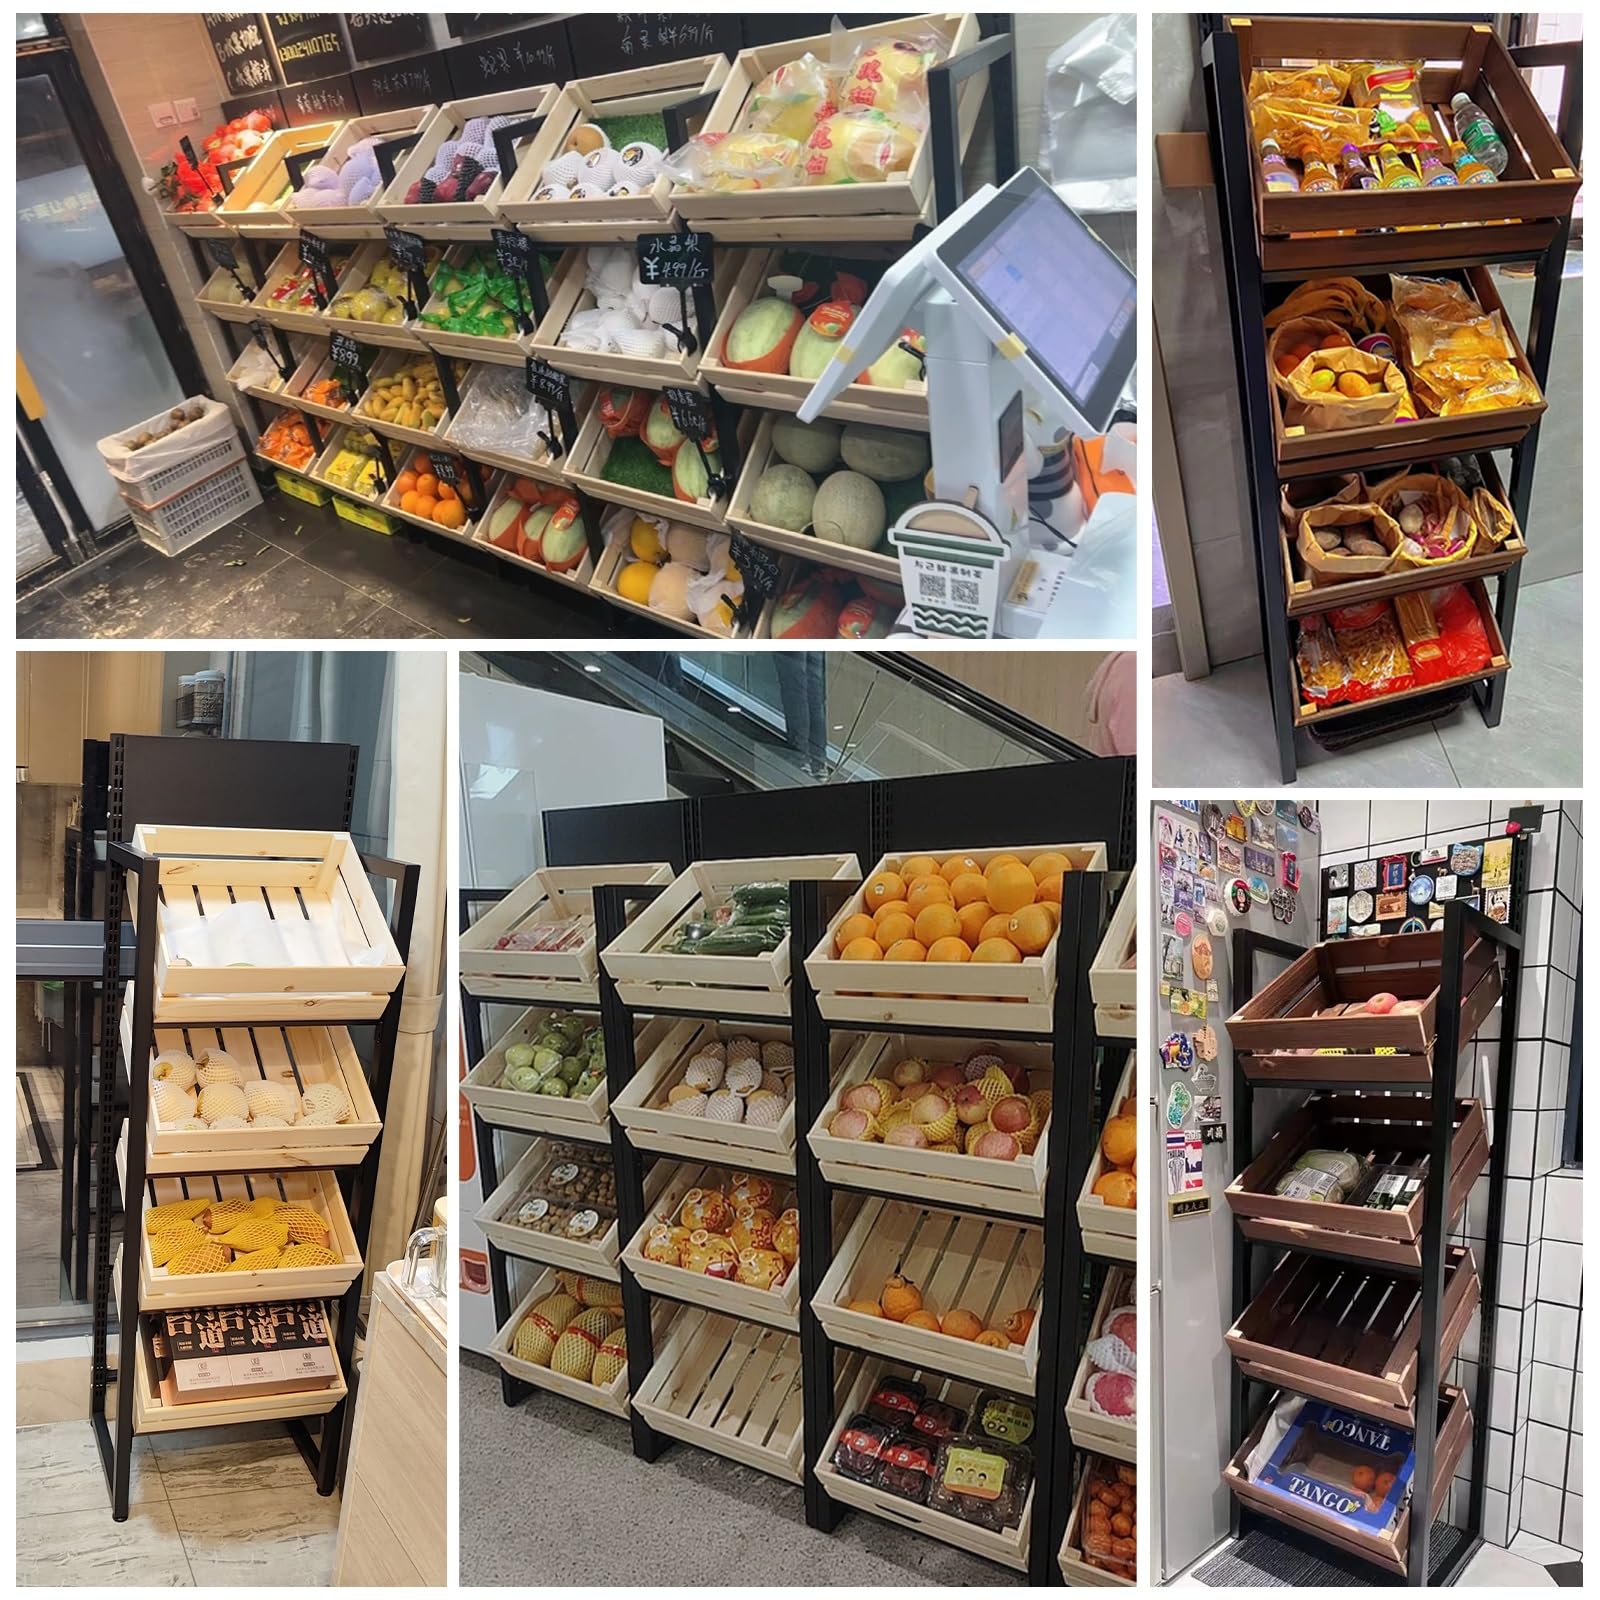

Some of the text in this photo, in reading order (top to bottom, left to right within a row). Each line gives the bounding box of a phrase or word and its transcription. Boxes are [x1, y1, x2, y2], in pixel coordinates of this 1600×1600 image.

[649, 233, 702, 254] 水晶梨
[1331, 1419, 1391, 1451] TANGO
[1288, 1477, 1354, 1514] TANGO
